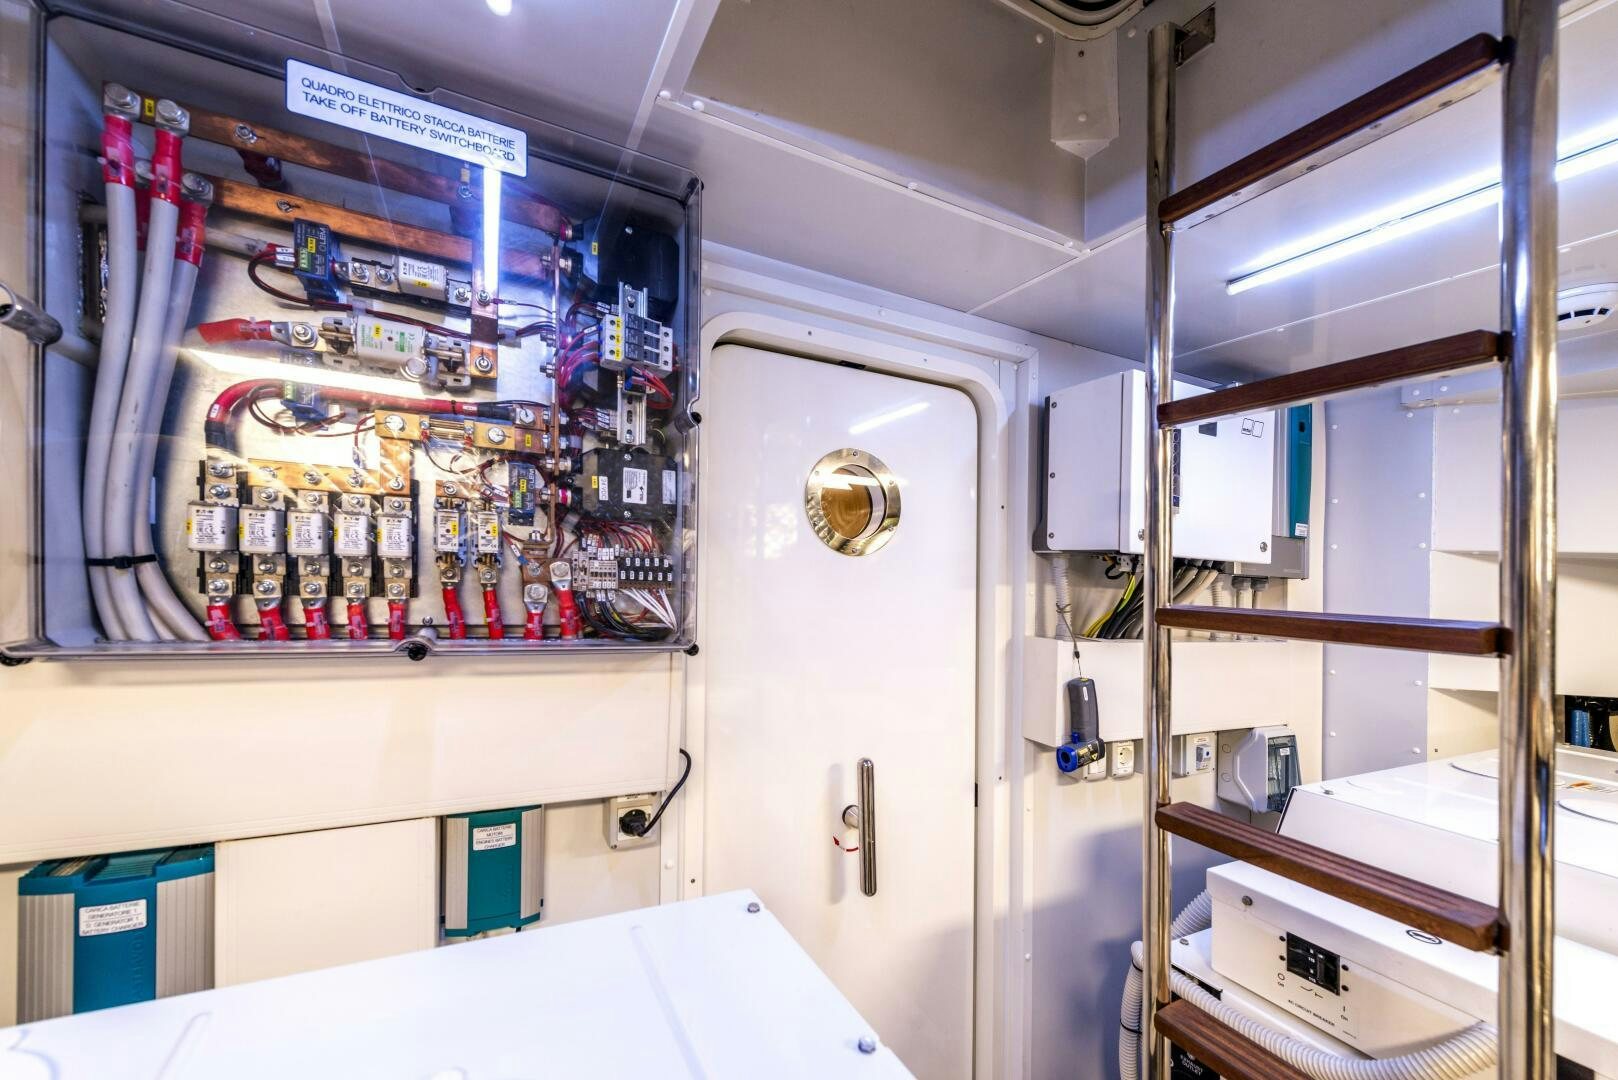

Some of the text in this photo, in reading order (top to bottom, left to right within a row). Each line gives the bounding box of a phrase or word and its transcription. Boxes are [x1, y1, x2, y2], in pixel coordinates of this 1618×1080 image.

[301, 77, 516, 150] QUADRO ELETTRICO STACCA BATTERIE
[302, 91, 336, 109] TAKE
[340, 103, 366, 117] OFF
[370, 112, 426, 136] BATTERY
